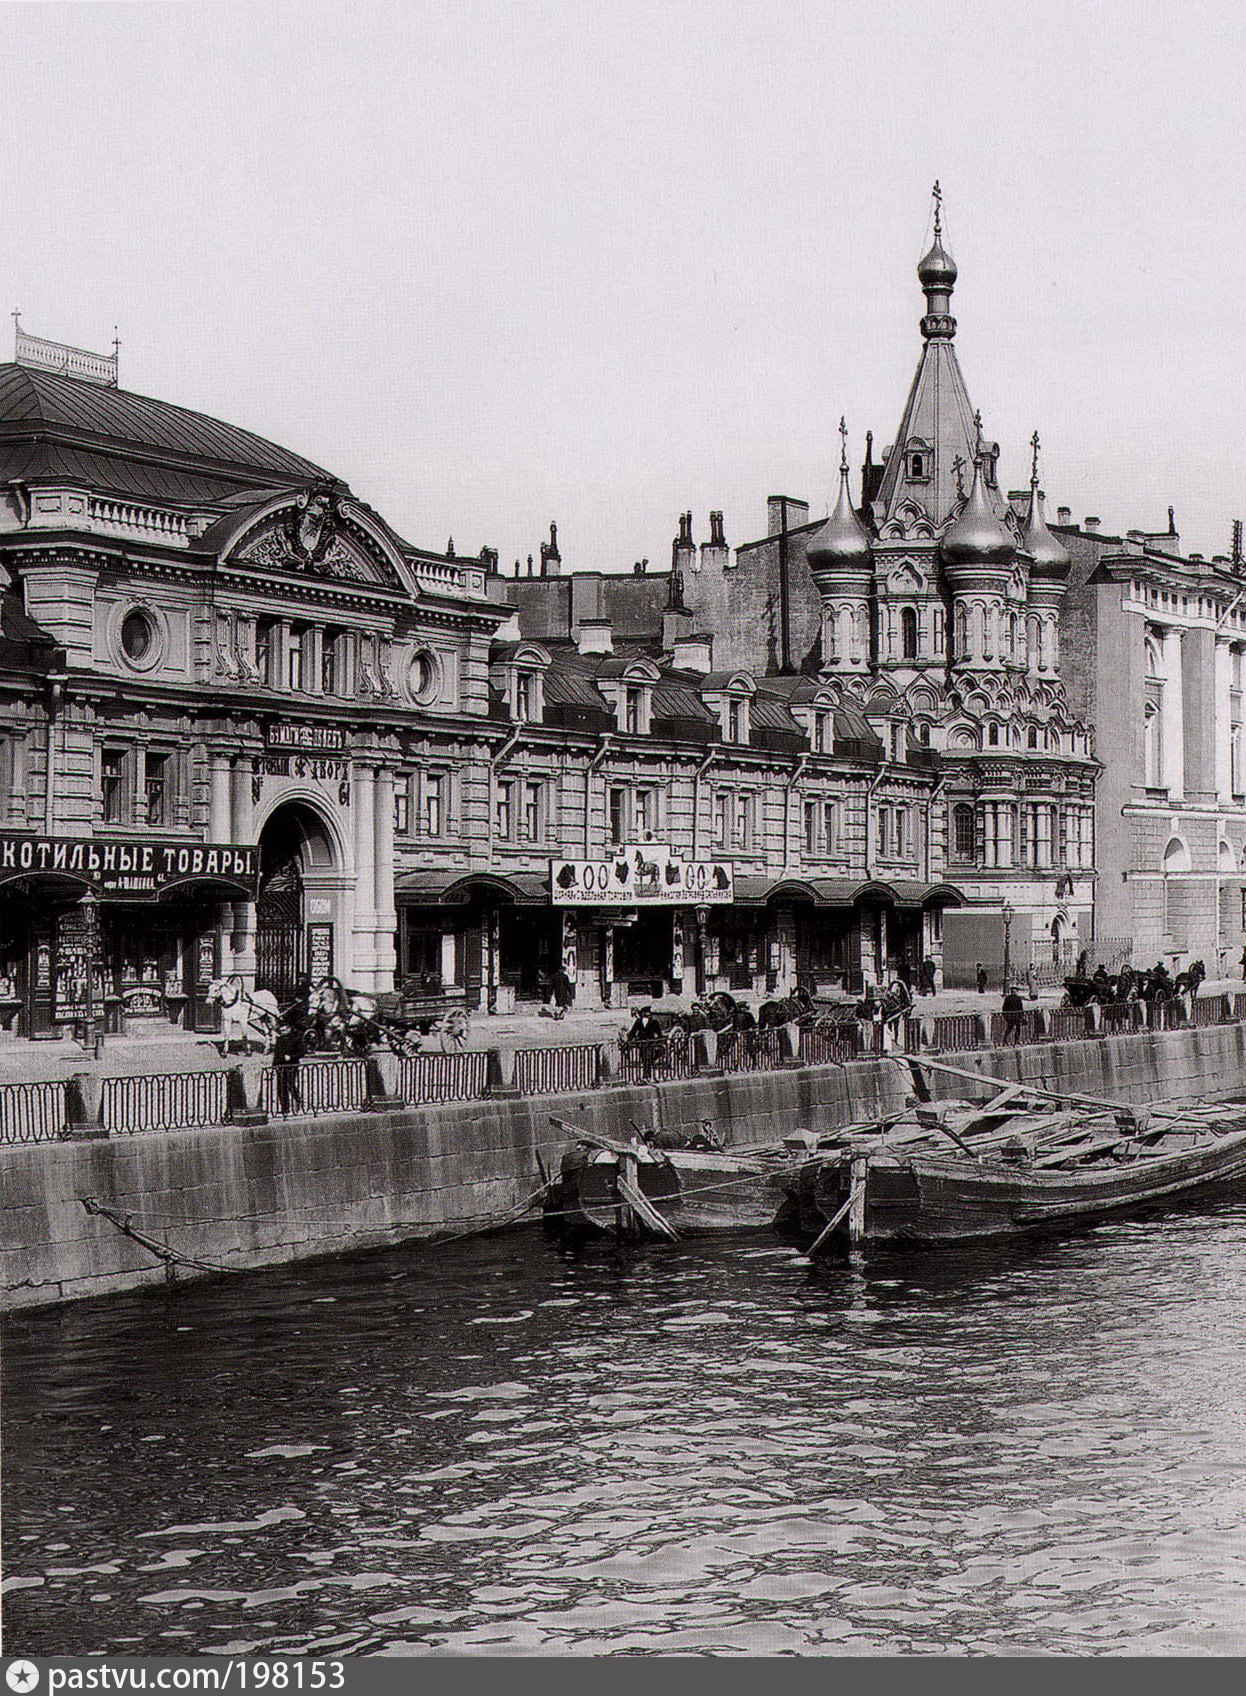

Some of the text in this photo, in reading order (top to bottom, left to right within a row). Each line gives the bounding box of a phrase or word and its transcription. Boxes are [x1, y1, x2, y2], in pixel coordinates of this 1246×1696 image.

[338, 781, 350, 807] 61
[2, 840, 256, 875] КОТИЛЬНЫЕ ТОВАРЫ.
